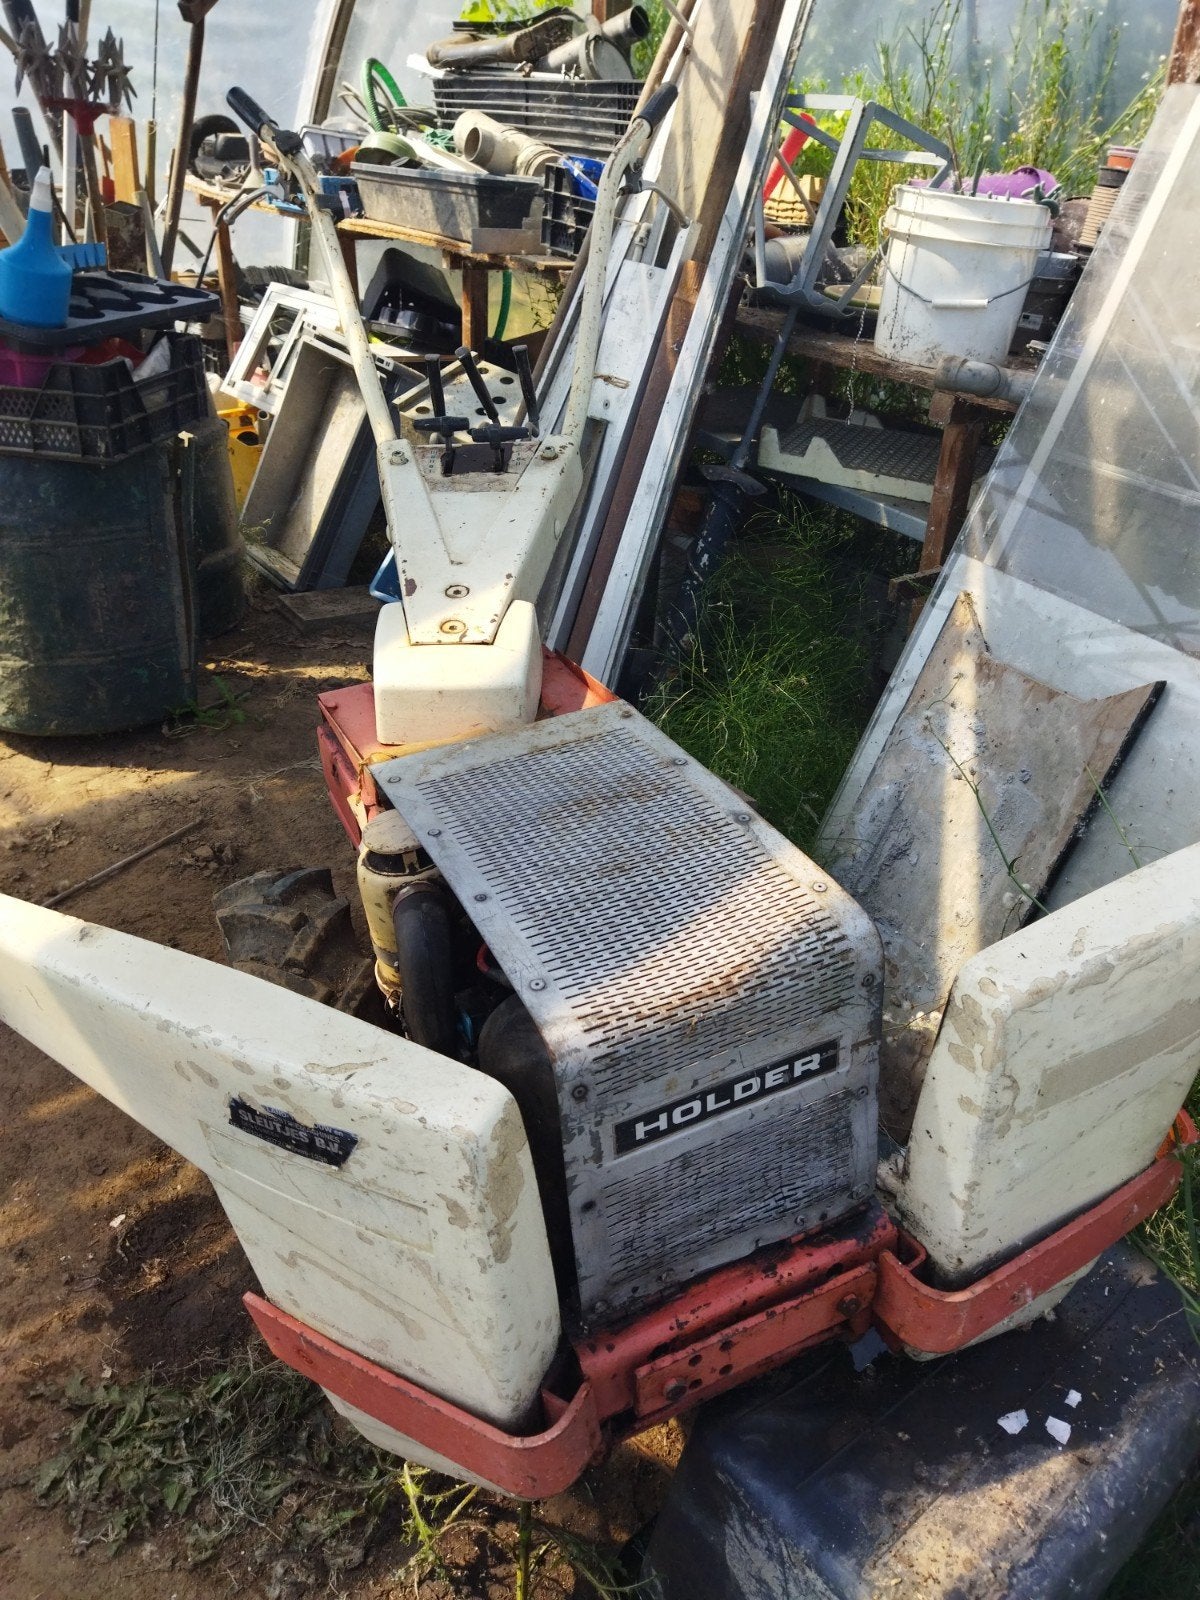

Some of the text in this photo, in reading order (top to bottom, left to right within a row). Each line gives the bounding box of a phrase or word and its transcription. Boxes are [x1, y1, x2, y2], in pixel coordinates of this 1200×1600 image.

[635, 1052, 822, 1141] HOLDER
[238, 1109, 309, 1143] SLEUTJES
[314, 1136, 343, 1155] B.V.
